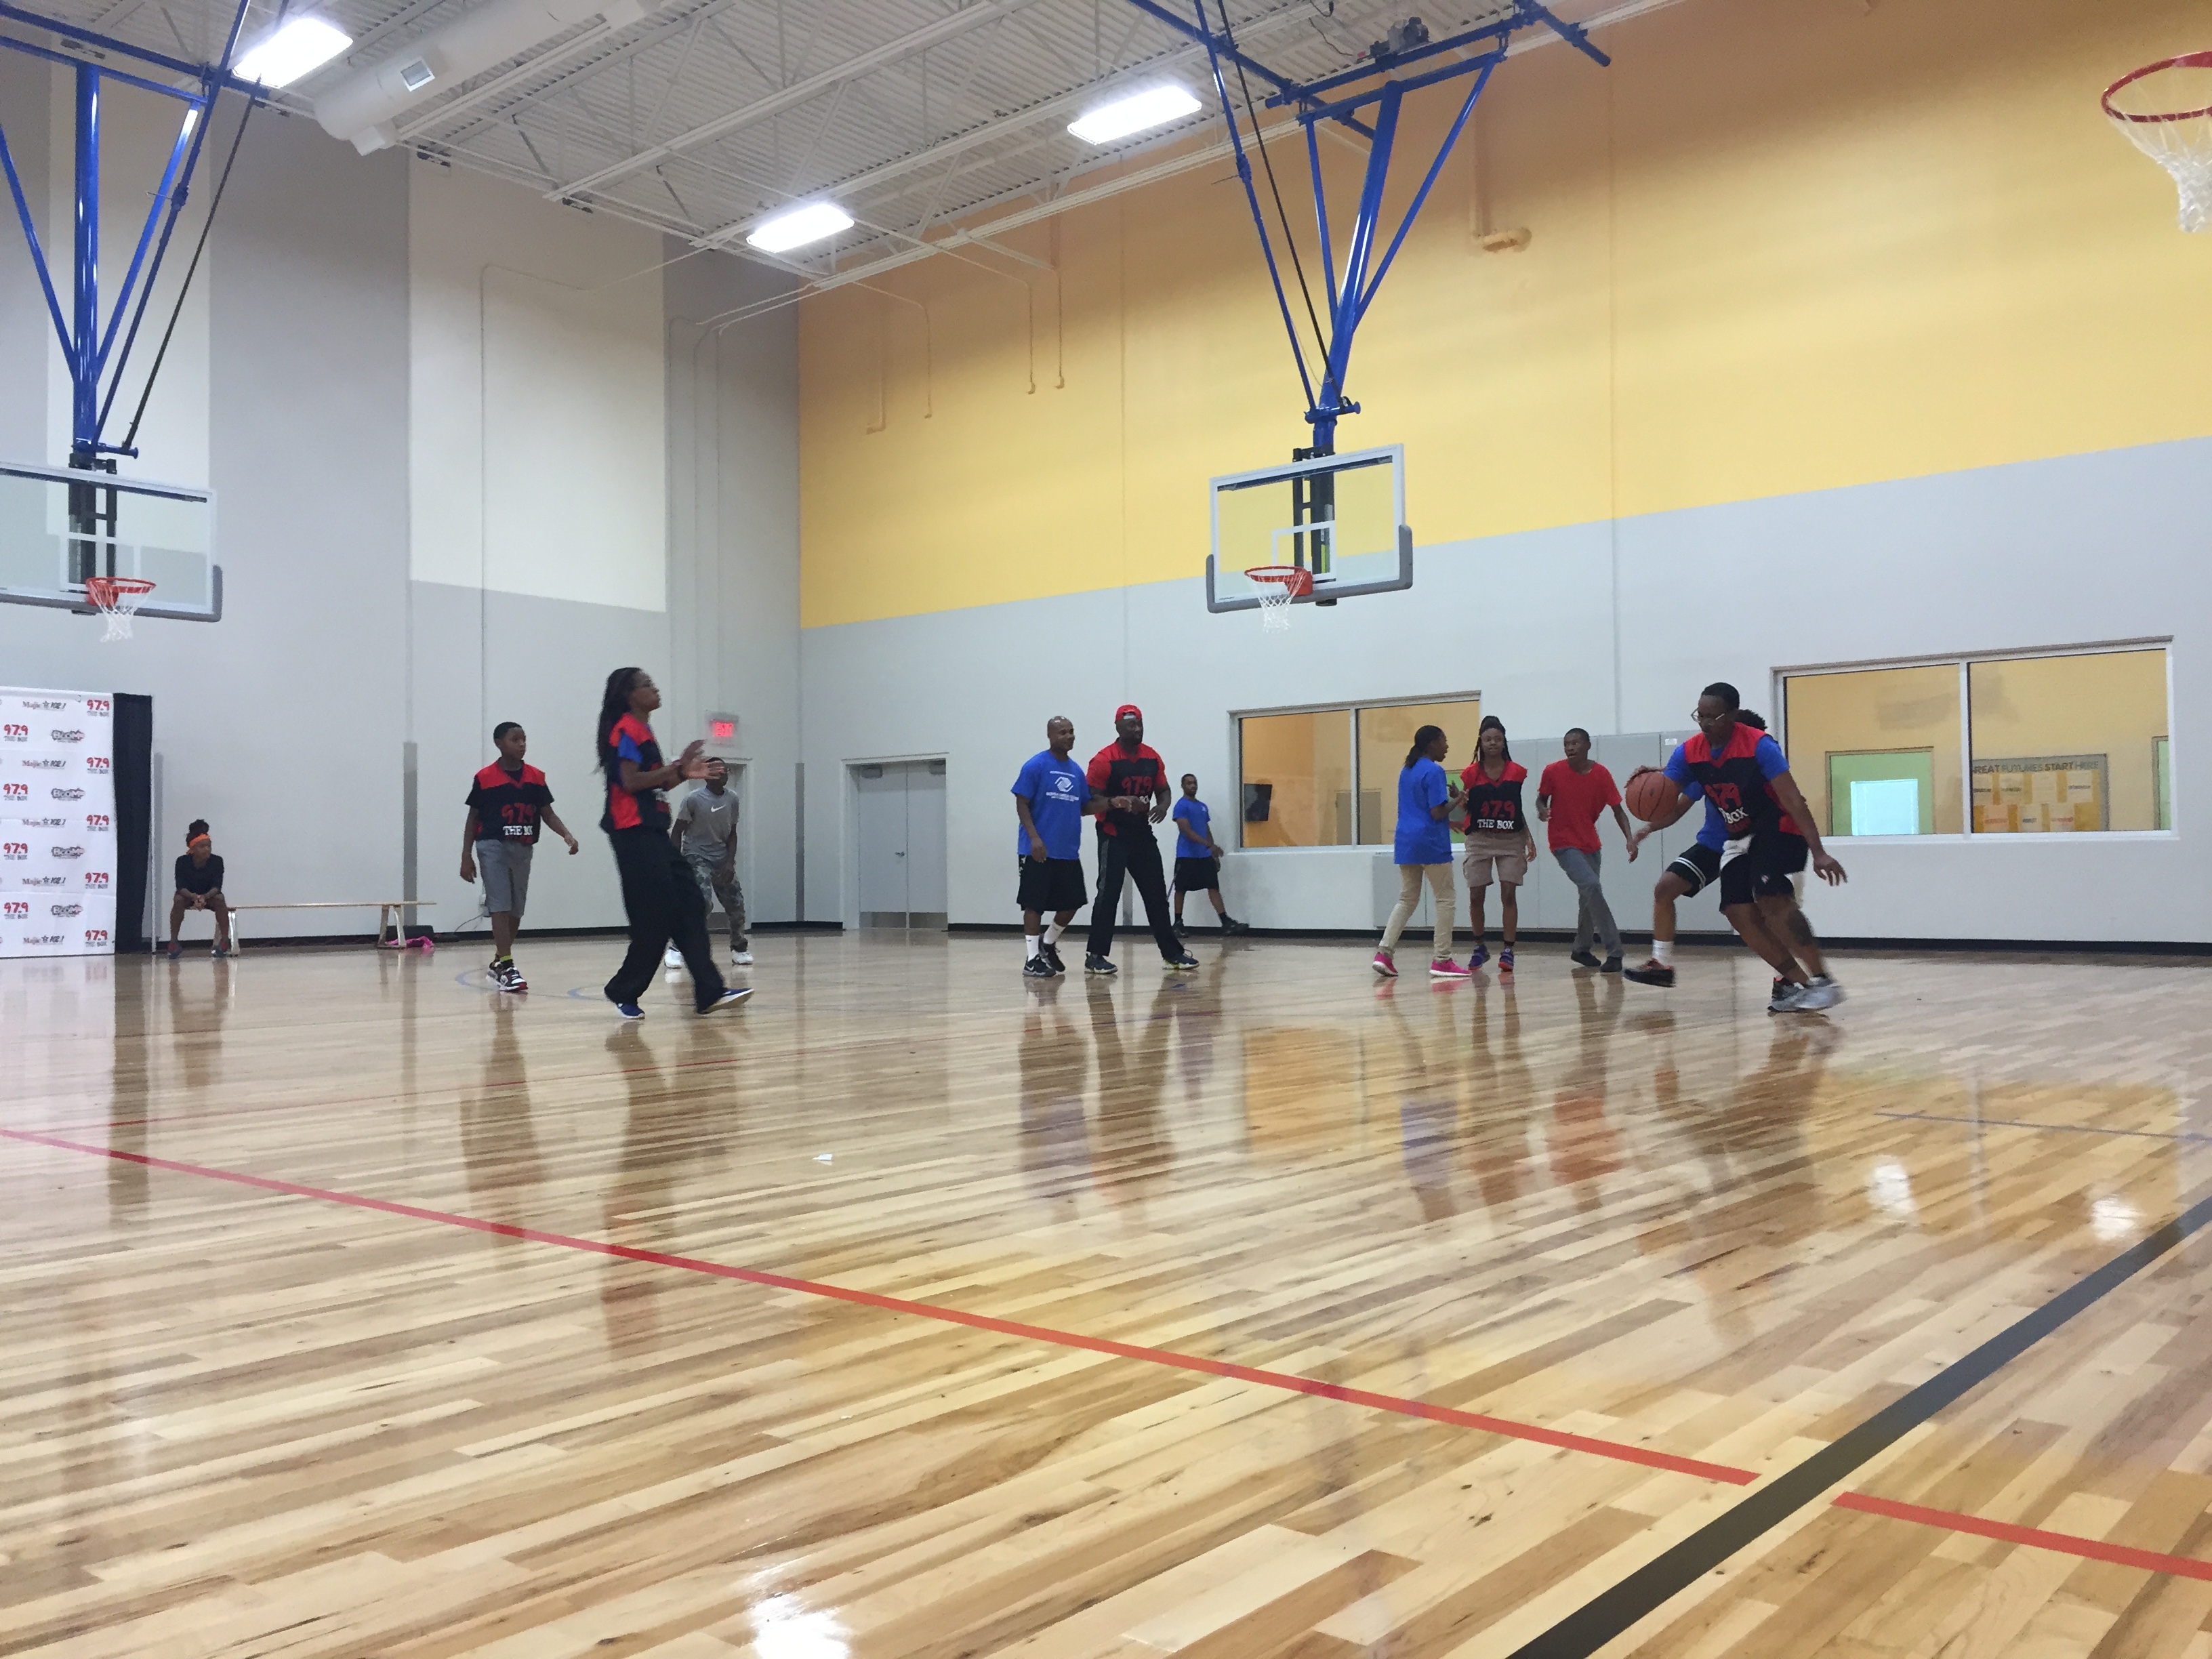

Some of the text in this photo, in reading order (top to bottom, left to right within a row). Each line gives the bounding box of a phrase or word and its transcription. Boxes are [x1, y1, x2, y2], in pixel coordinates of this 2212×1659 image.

[87, 699, 110, 711] 97.9
[4, 724, 28, 735] 97.9
[87, 757, 109, 768] 97.9
[2045, 761, 2073, 771] START
[3, 783, 28, 795] 97.9
[86, 815, 109, 825] 97.9
[1477, 819, 1514, 830] THE BOX
[503, 825, 523, 836] THE
[4, 842, 28, 854] 97.9
[85, 872, 108, 883] 97.9
[4, 902, 28, 913] 97.9
[85, 930, 108, 941] 97.9
